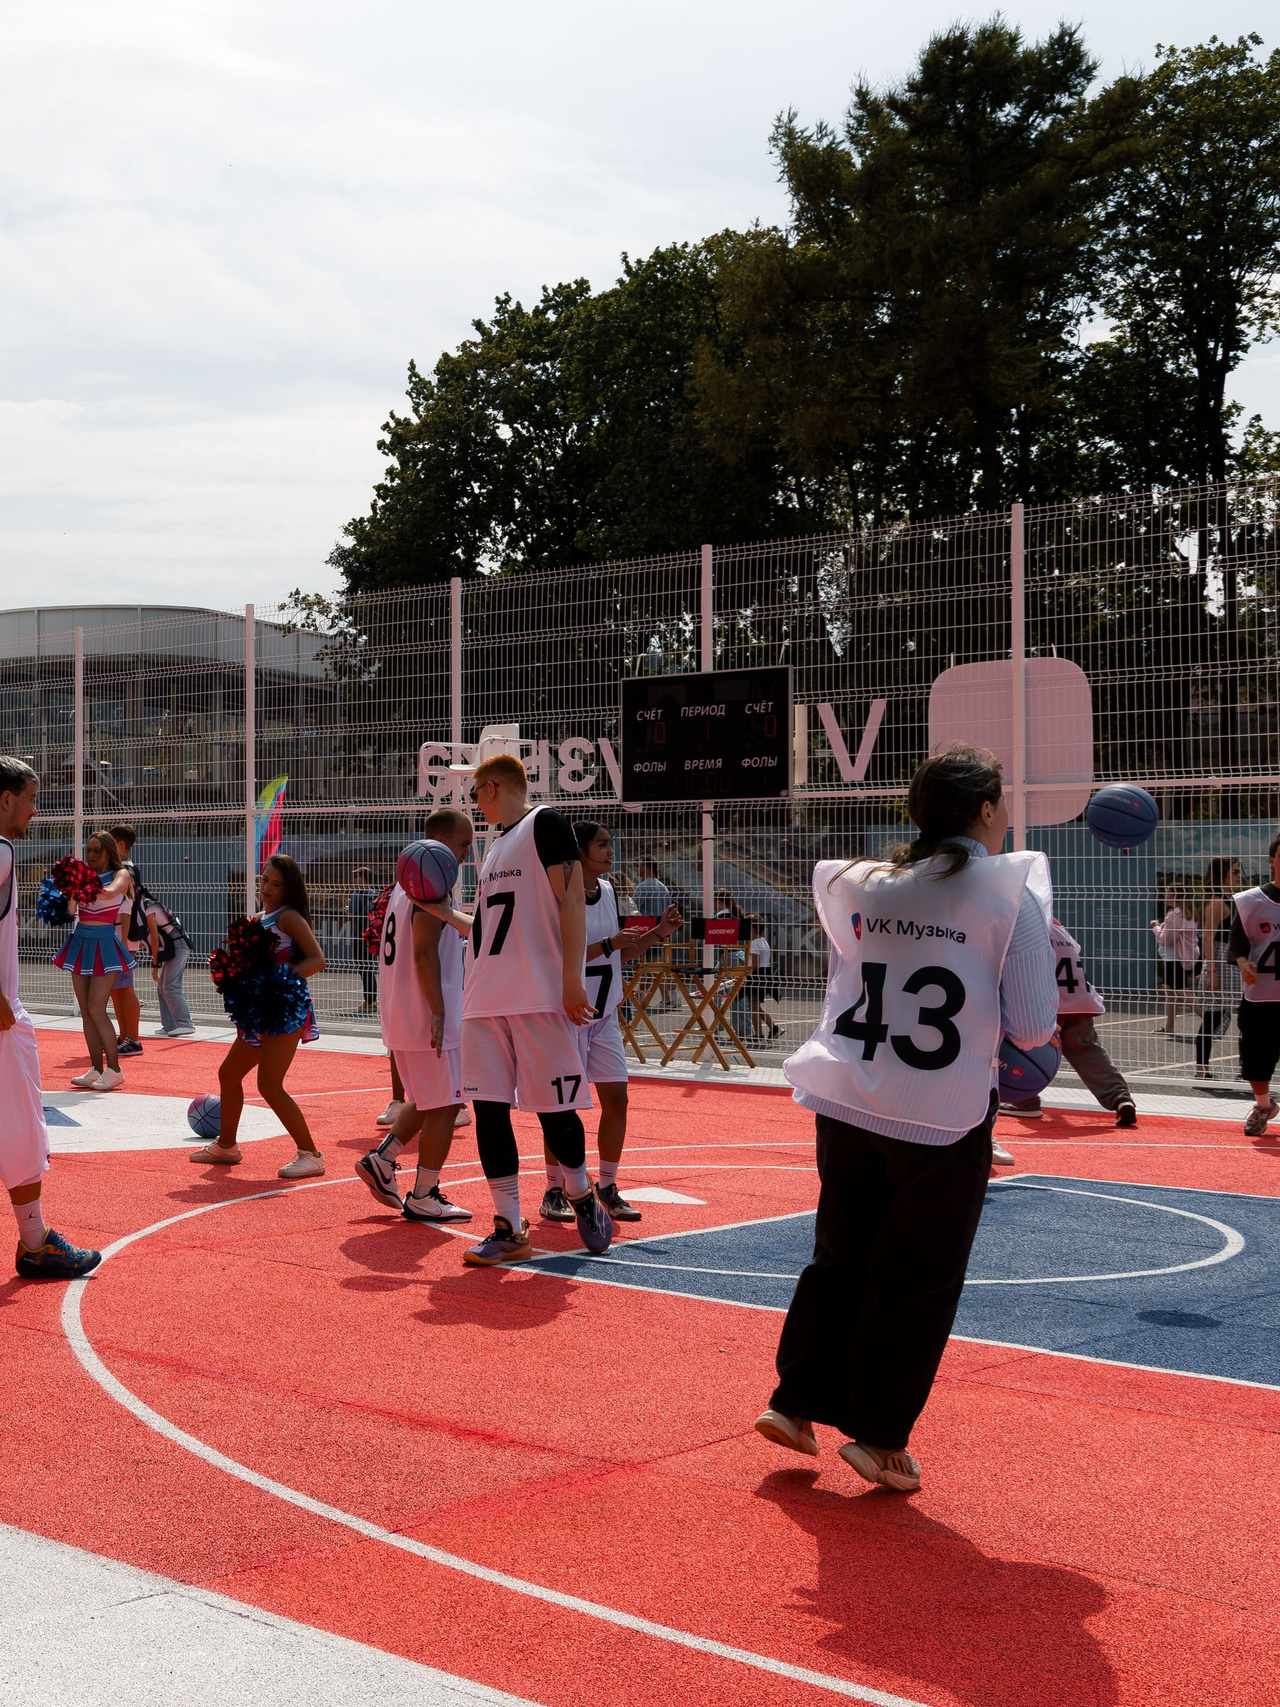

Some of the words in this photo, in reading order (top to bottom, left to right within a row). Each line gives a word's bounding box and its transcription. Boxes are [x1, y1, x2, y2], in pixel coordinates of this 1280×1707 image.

[680, 704, 726, 717] ПЕРИОД
[744, 700, 774, 714] СЧЁТ
[636, 708, 663, 721] СЧЁТ
[633, 761, 667, 773] ФОЛЫ
[684, 758, 723, 770] ВРЕМЯ
[741, 756, 778, 768] ФОЛЫ
[489, 869, 522, 882] Музыка
[472, 891, 516, 961] 17
[866, 918, 892, 935] VK
[896, 919, 967, 945] Музыка
[832, 961, 966, 1071] 43
[551, 1074, 582, 1105] 17
